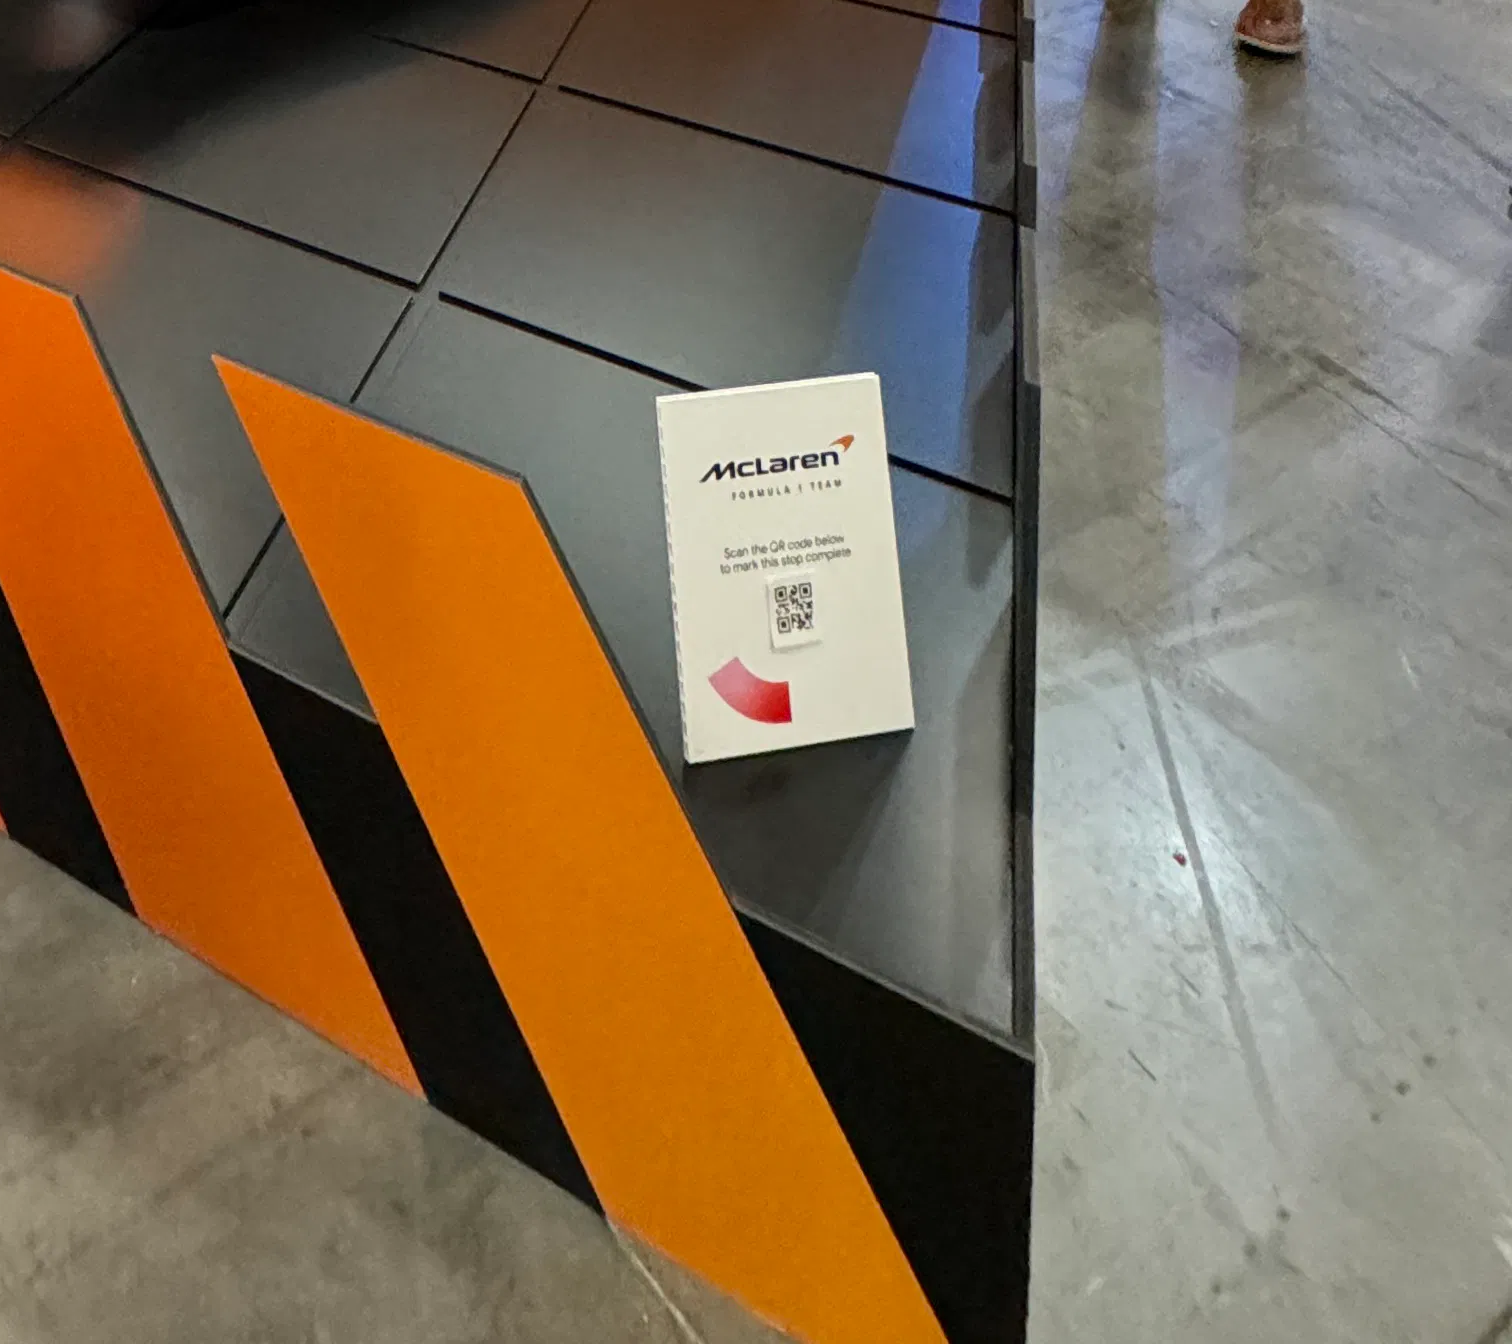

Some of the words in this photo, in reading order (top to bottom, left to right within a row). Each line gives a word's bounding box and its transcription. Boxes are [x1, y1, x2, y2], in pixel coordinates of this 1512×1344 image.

[699, 450, 839, 483] McLaren
[731, 485, 791, 501] FORMULA
[810, 479, 842, 492] TEAM
[724, 546, 748, 560] Scan
[751, 543, 768, 556] the
[770, 539, 785, 553] QR
[788, 537, 813, 551] code
[814, 533, 845, 547] below
[720, 563, 731, 575] to
[732, 559, 758, 574] mark
[760, 556, 779, 570] this
[781, 553, 803, 568] stop
[805, 547, 852, 563] complete
